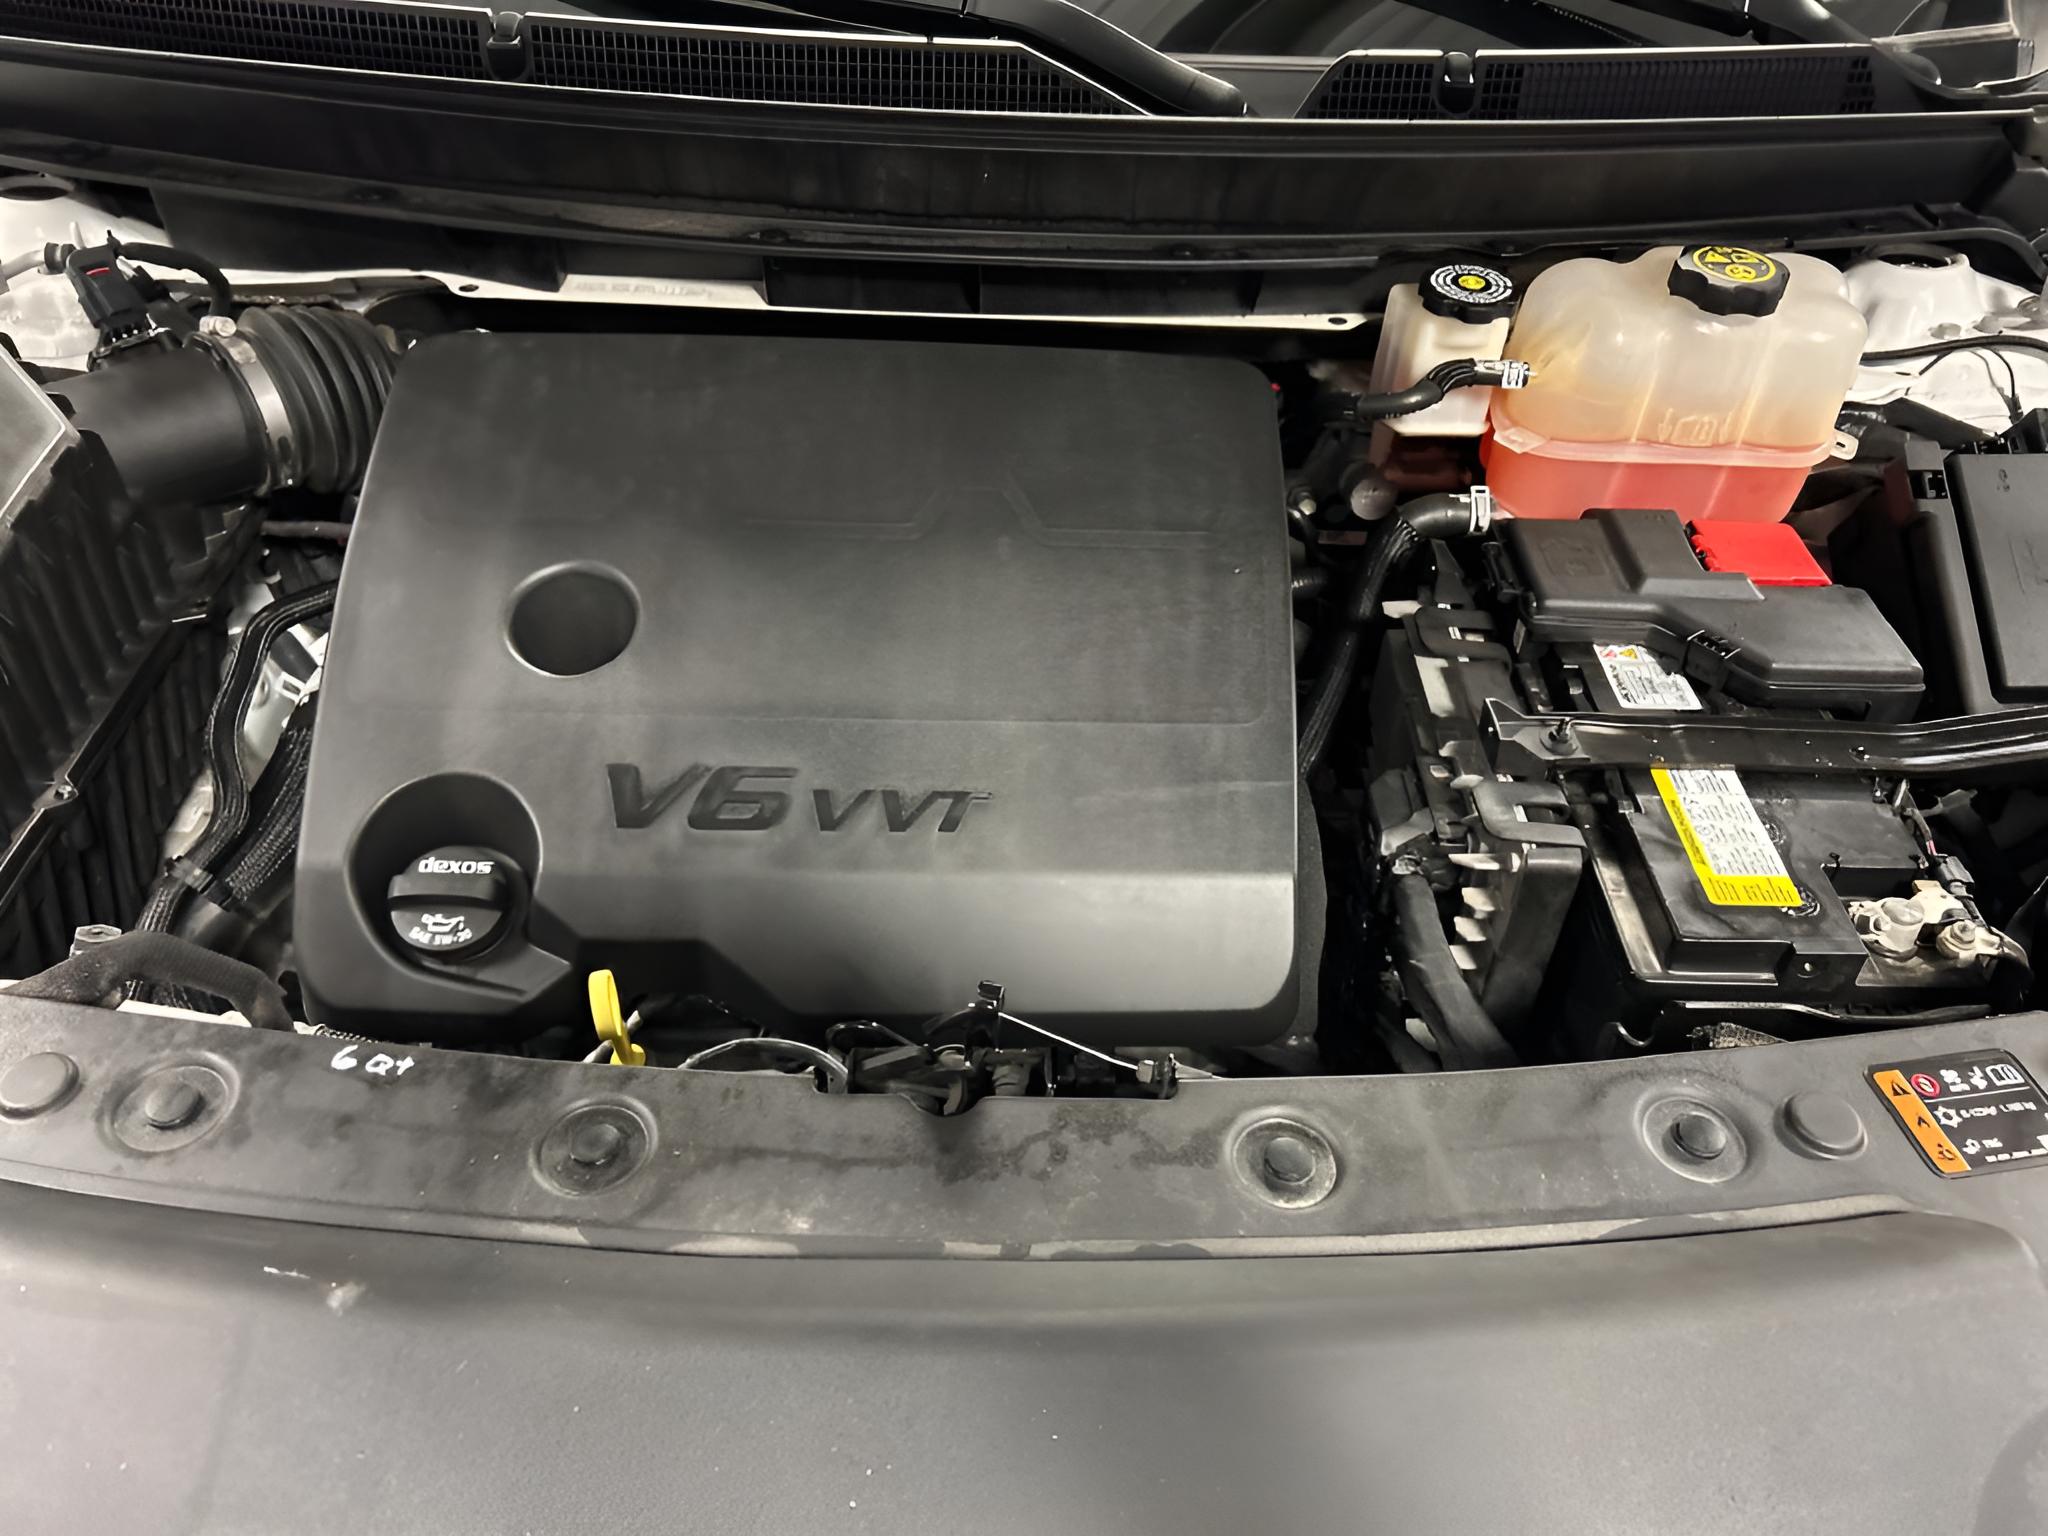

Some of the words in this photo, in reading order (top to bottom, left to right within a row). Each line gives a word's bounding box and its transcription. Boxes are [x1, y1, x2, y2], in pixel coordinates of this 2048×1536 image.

[607, 763, 799, 831] V6
[812, 788, 993, 833] VVT
[418, 856, 495, 874] dexos
[331, 1044, 358, 1070] 6
